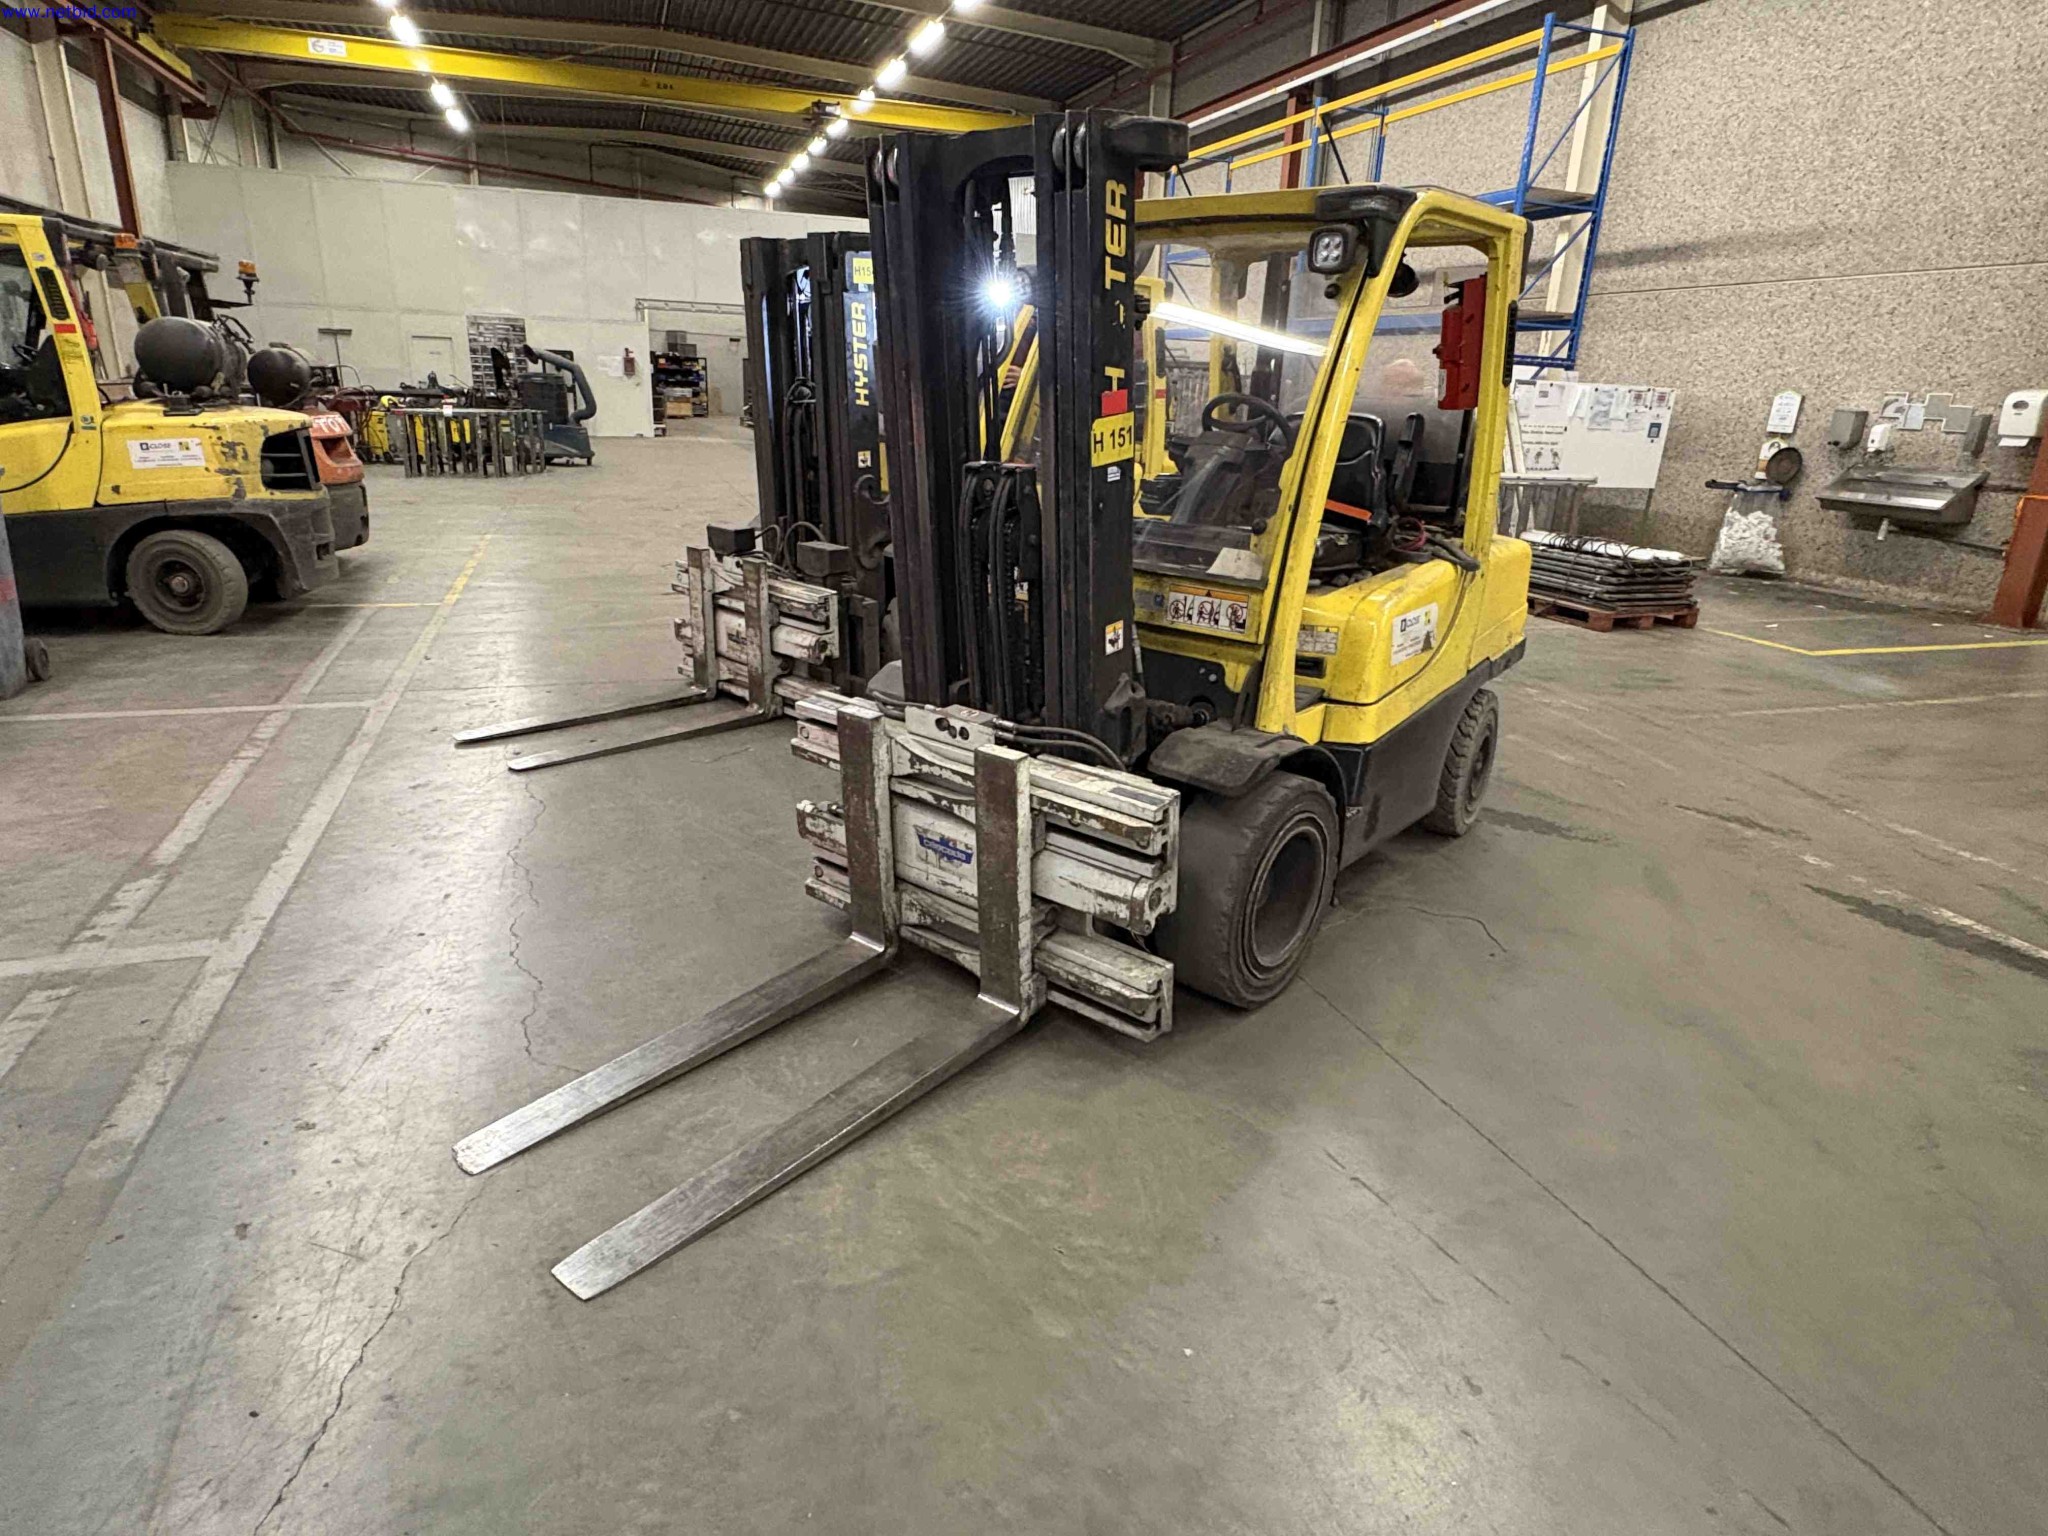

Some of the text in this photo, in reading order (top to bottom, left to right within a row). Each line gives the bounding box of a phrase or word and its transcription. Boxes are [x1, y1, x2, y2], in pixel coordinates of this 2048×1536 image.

[850, 301, 870, 407] HYSTER
[1093, 424, 1133, 454] H 151
